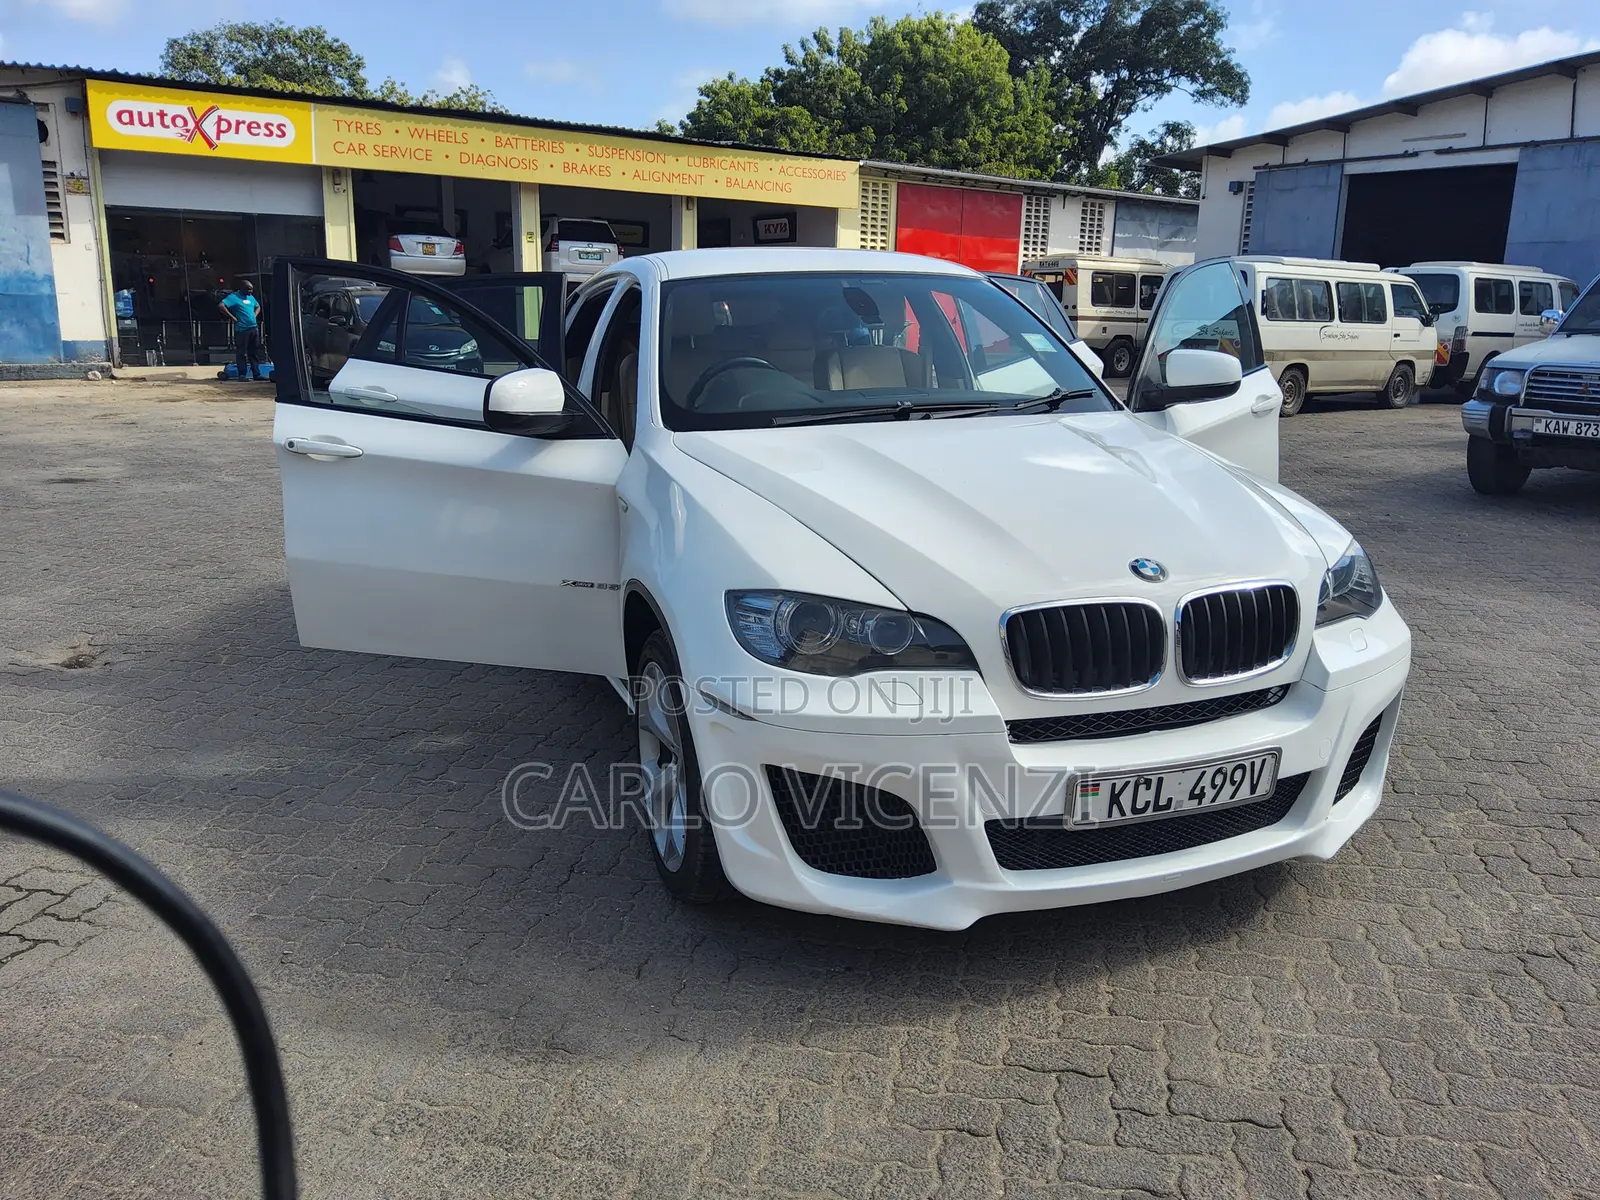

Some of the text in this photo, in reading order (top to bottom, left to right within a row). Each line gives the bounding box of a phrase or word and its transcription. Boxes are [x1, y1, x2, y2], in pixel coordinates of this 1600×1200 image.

[116, 104, 287, 150] autoXpress
[333, 119, 847, 181] TYRES WHEELS BATTERIES SUSPENSION LUBRICANTS ACCESSORIES
[333, 141, 792, 193] CAR SERVICE DIAGNOSIS BRAKES ALIGNMENT BALANCING
[1544, 420, 1600, 437] KAW 873
[1108, 776, 1173, 818] KCL
[1188, 758, 1267, 805] 499V
